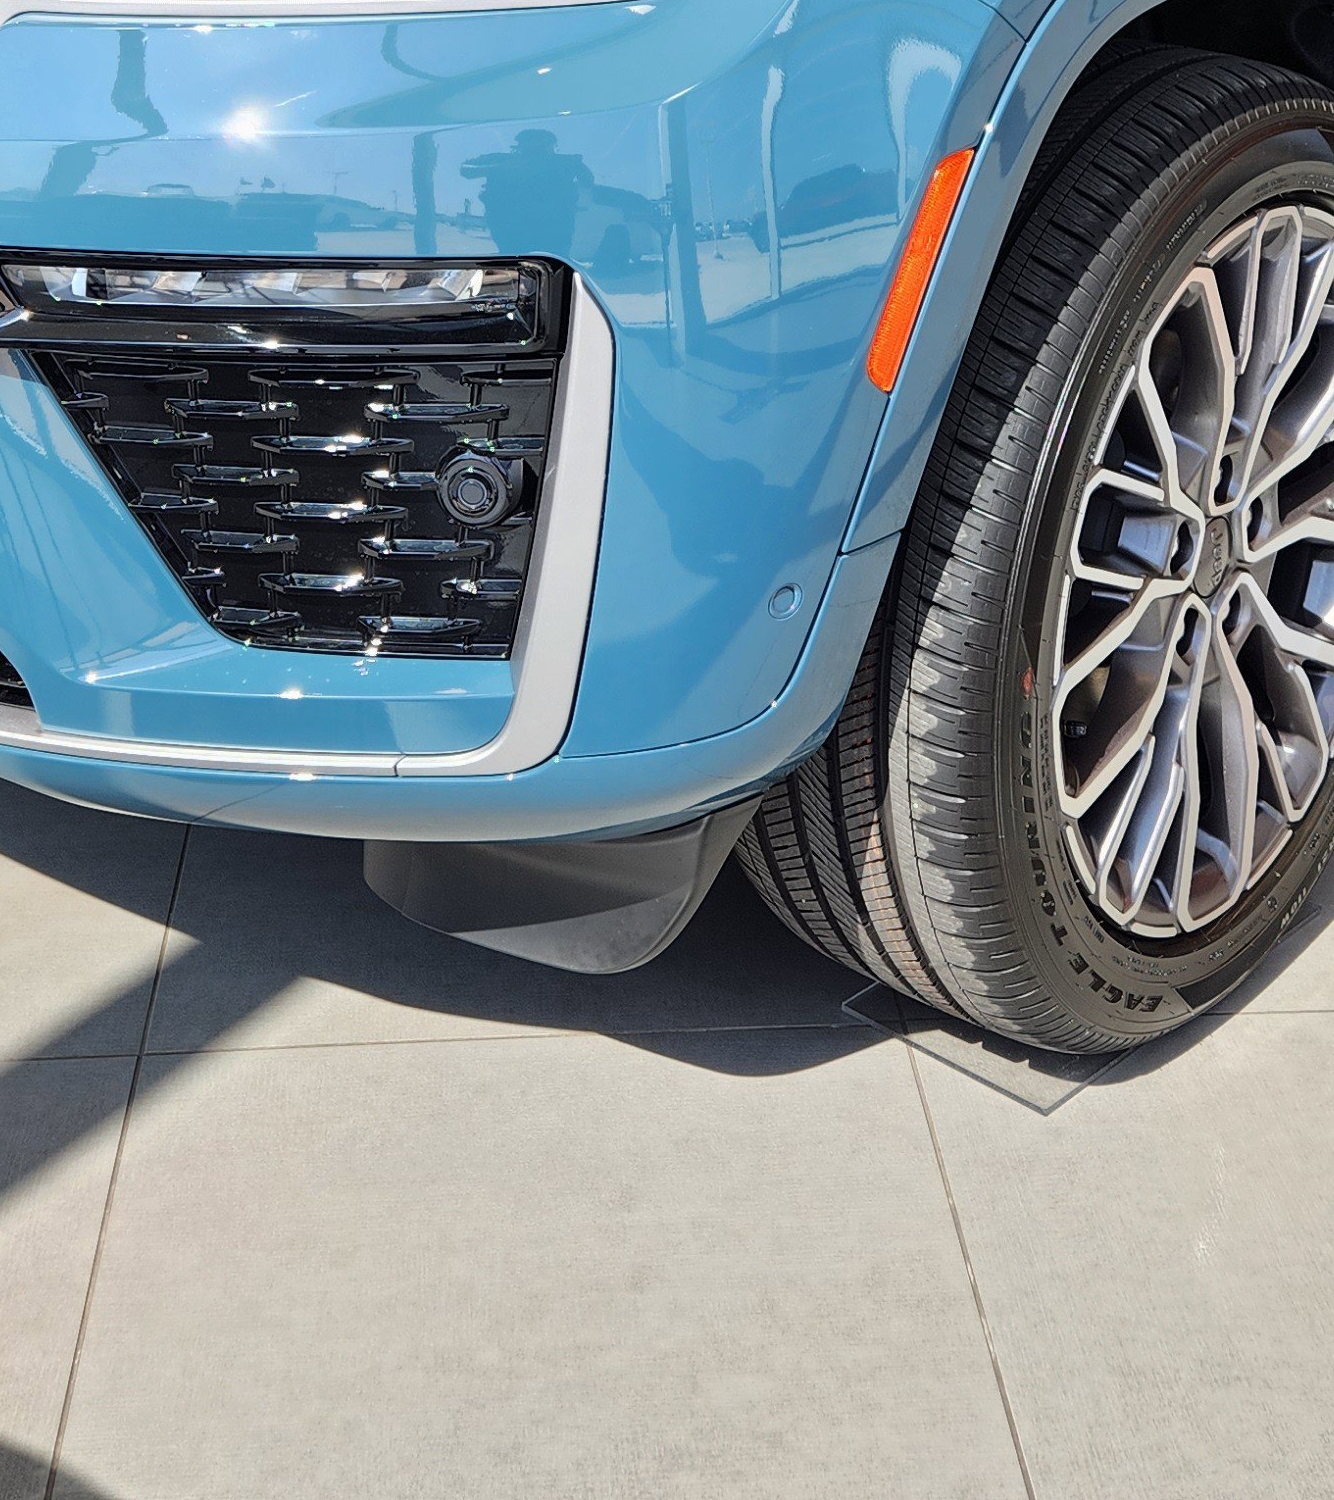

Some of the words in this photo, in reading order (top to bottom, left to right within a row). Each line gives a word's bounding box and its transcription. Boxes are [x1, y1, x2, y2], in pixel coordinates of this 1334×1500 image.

[1204, 523, 1223, 576] Jeep
[1019, 711, 1069, 947] TOURING
[1067, 951, 1164, 1013] EAGLE
